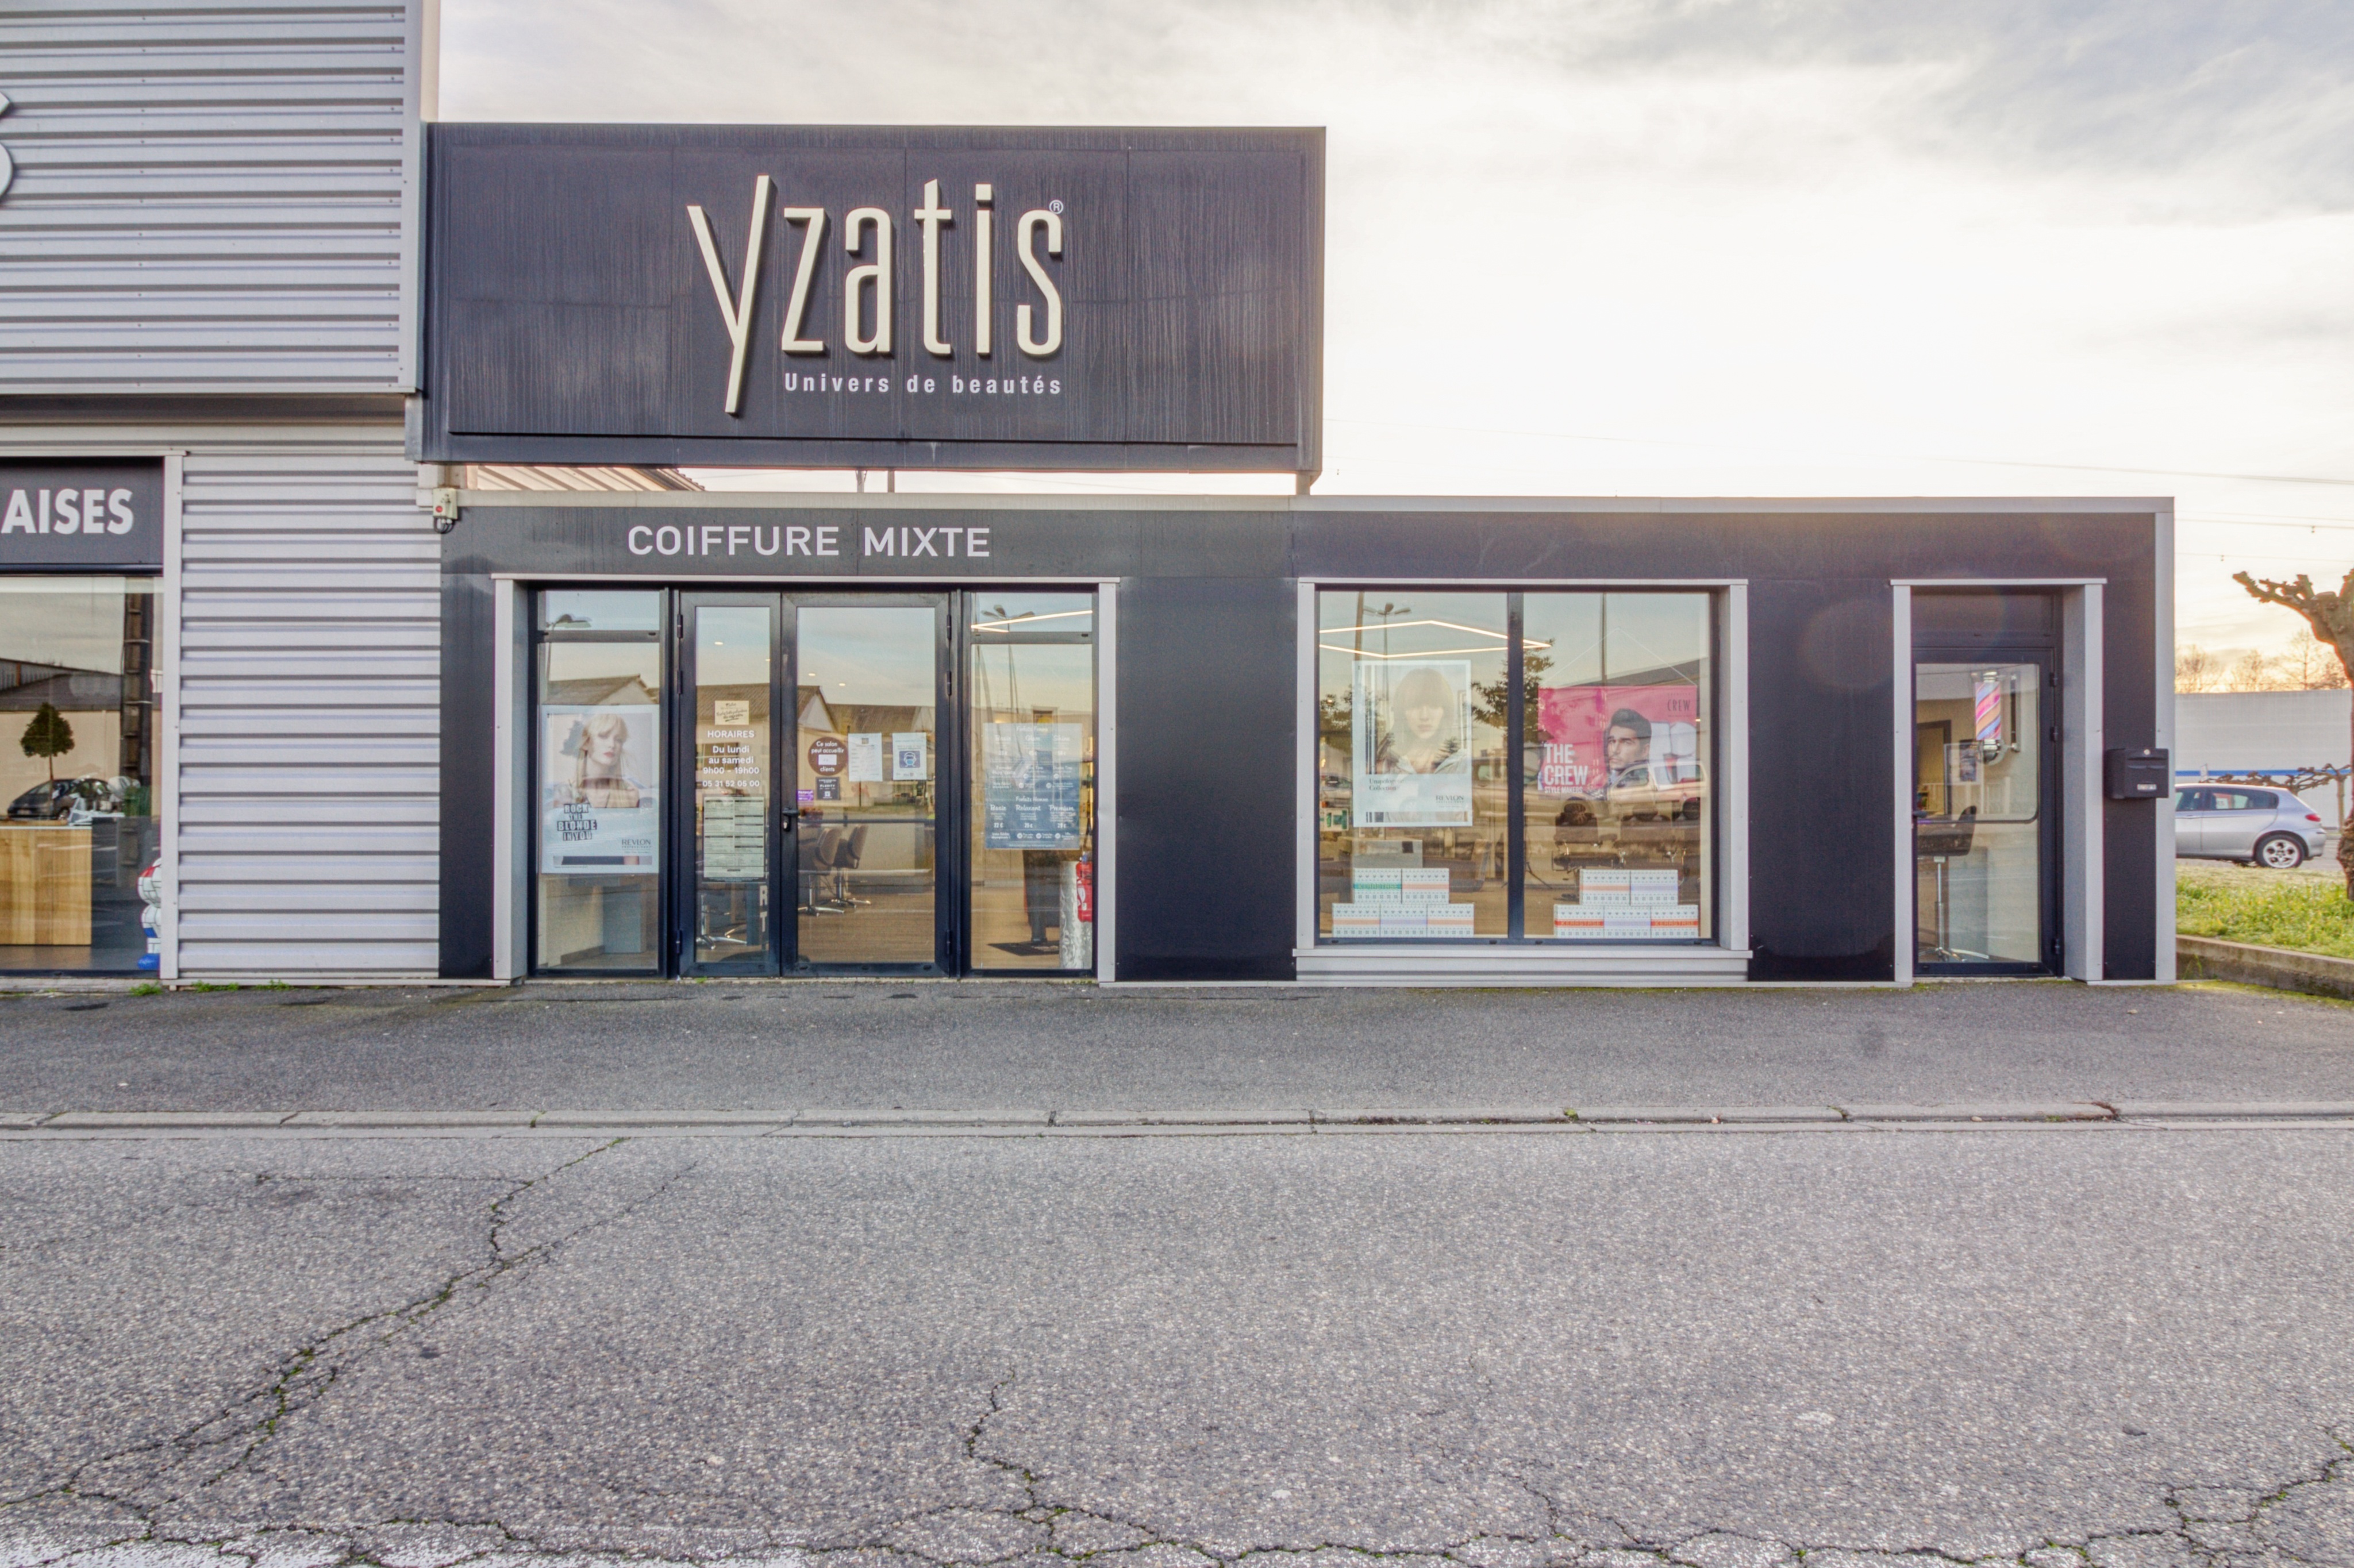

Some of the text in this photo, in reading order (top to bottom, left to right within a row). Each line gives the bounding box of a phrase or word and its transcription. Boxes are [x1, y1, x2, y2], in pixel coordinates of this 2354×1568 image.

[784, 372, 1061, 394] Univers de beautés
[1, 488, 134, 535] AISES
[628, 525, 990, 557] COIFFURE MIXTE
[1667, 699, 1691, 712] CREW
[728, 745, 749, 753] lundi
[1544, 743, 1574, 764] THE
[722, 756, 753, 764] samedi
[1544, 765, 1588, 785] CREW
[564, 804, 588, 813] ROCK
[558, 820, 597, 831] BLONDE
[563, 831, 592, 841] IN YOU
